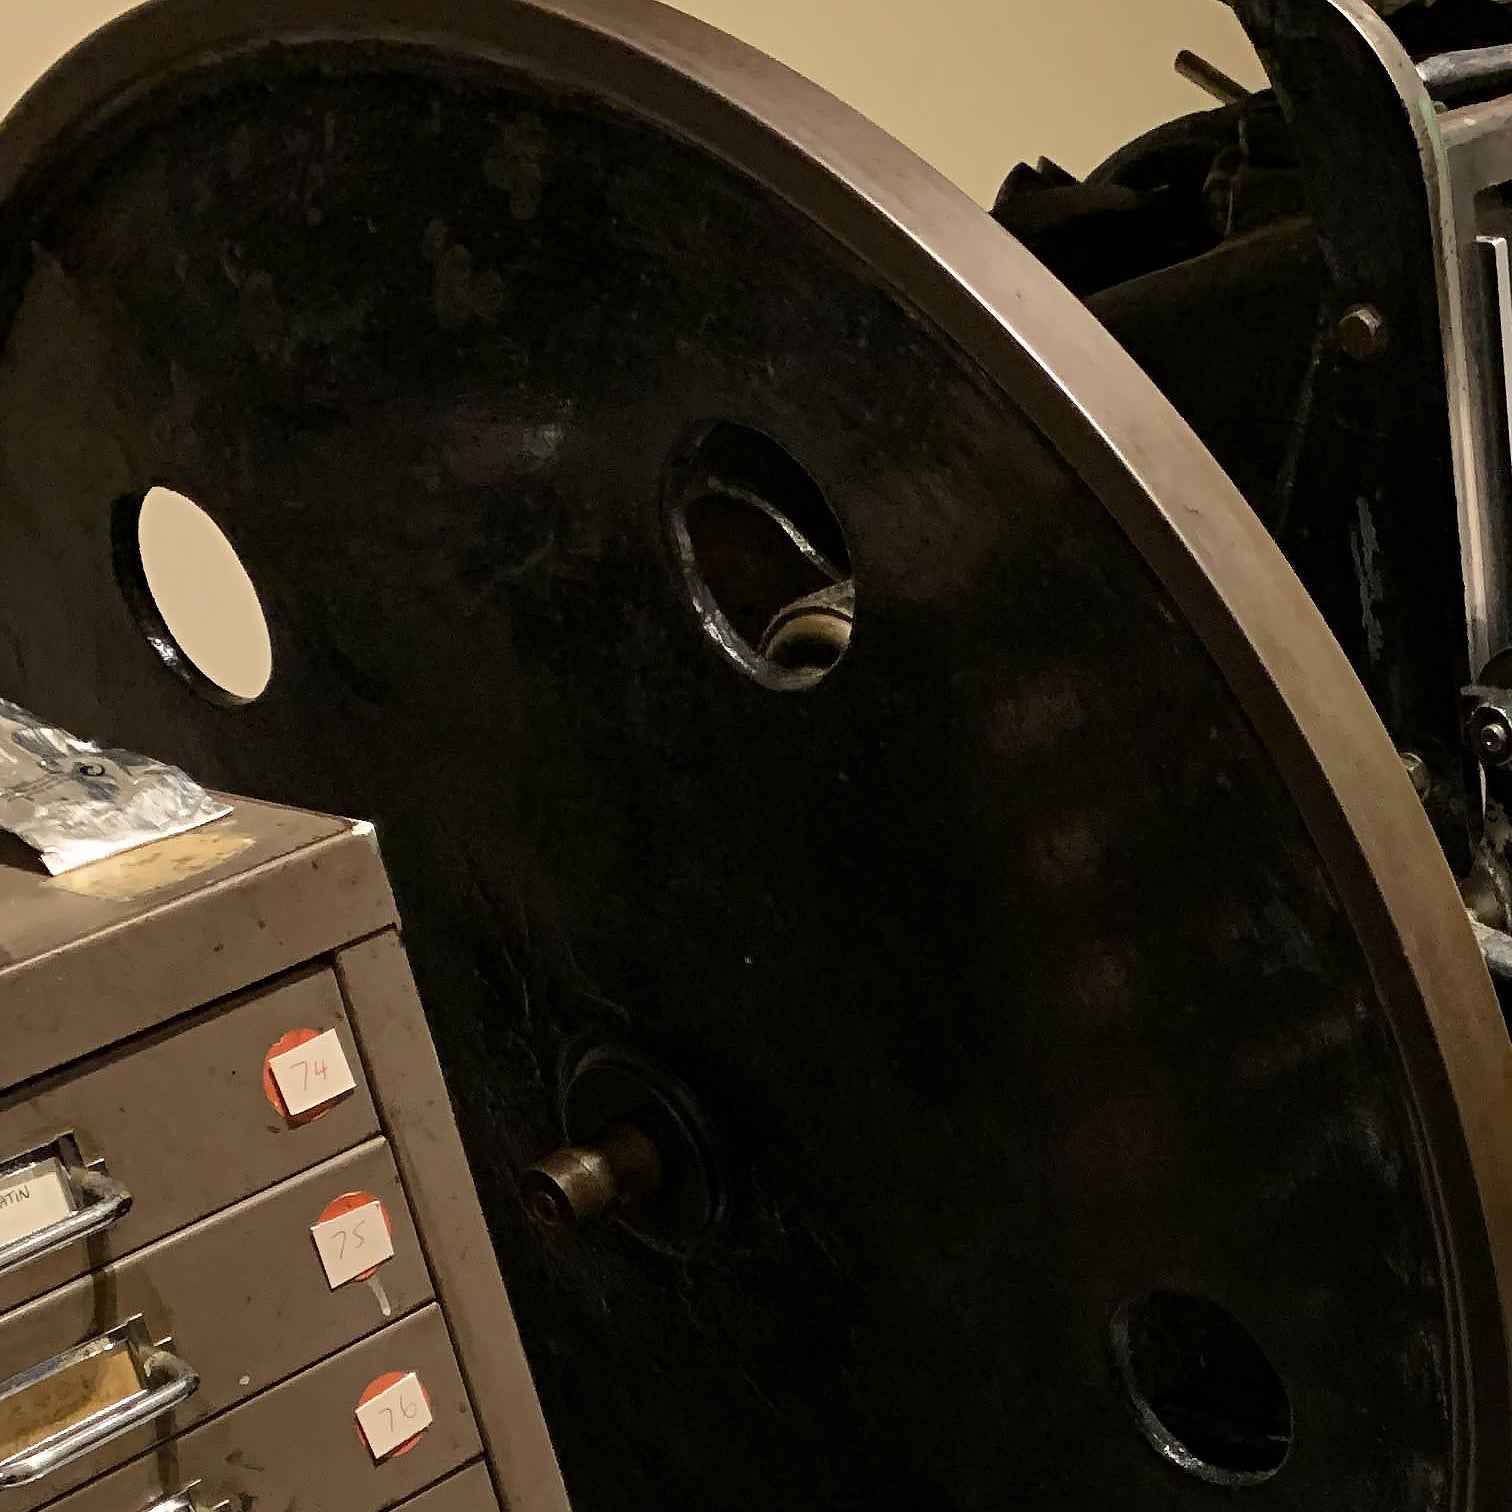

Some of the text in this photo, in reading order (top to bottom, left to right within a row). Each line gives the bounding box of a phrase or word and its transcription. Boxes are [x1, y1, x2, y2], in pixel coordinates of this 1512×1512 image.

[289, 1057, 327, 1092] 74
[330, 1219, 366, 1260] 75
[377, 1392, 418, 1434] 76
